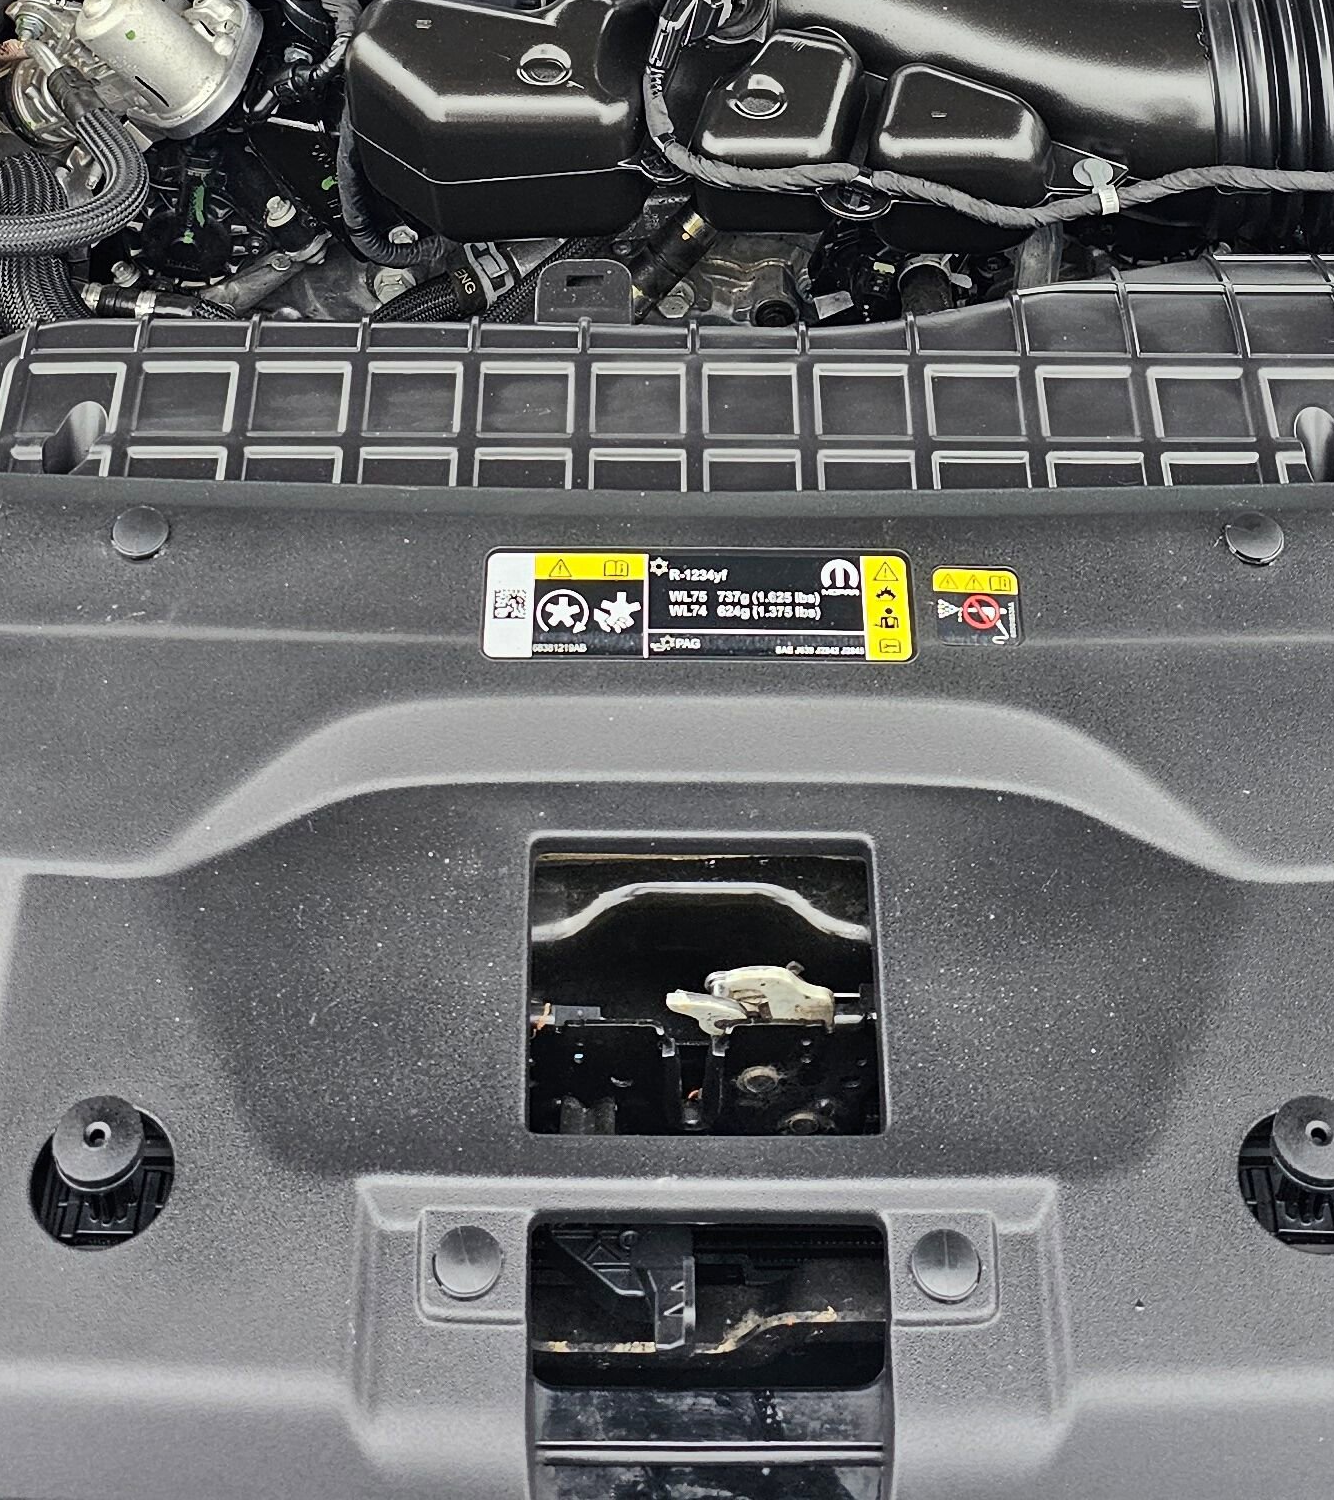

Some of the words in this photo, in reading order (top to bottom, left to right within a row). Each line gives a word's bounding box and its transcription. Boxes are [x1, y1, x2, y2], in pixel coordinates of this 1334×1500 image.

[454, 268, 476, 295] ENG
[668, 568, 728, 584] R-1234yf
[668, 590, 708, 603] WL75
[716, 590, 750, 606] 737g
[794, 591, 821, 606] lbs)
[668, 604, 708, 617] WL74
[716, 605, 751, 620] 624g
[751, 605, 794, 620] (1.375
[794, 605, 822, 621] lbs)
[675, 638, 701, 650] PAG
